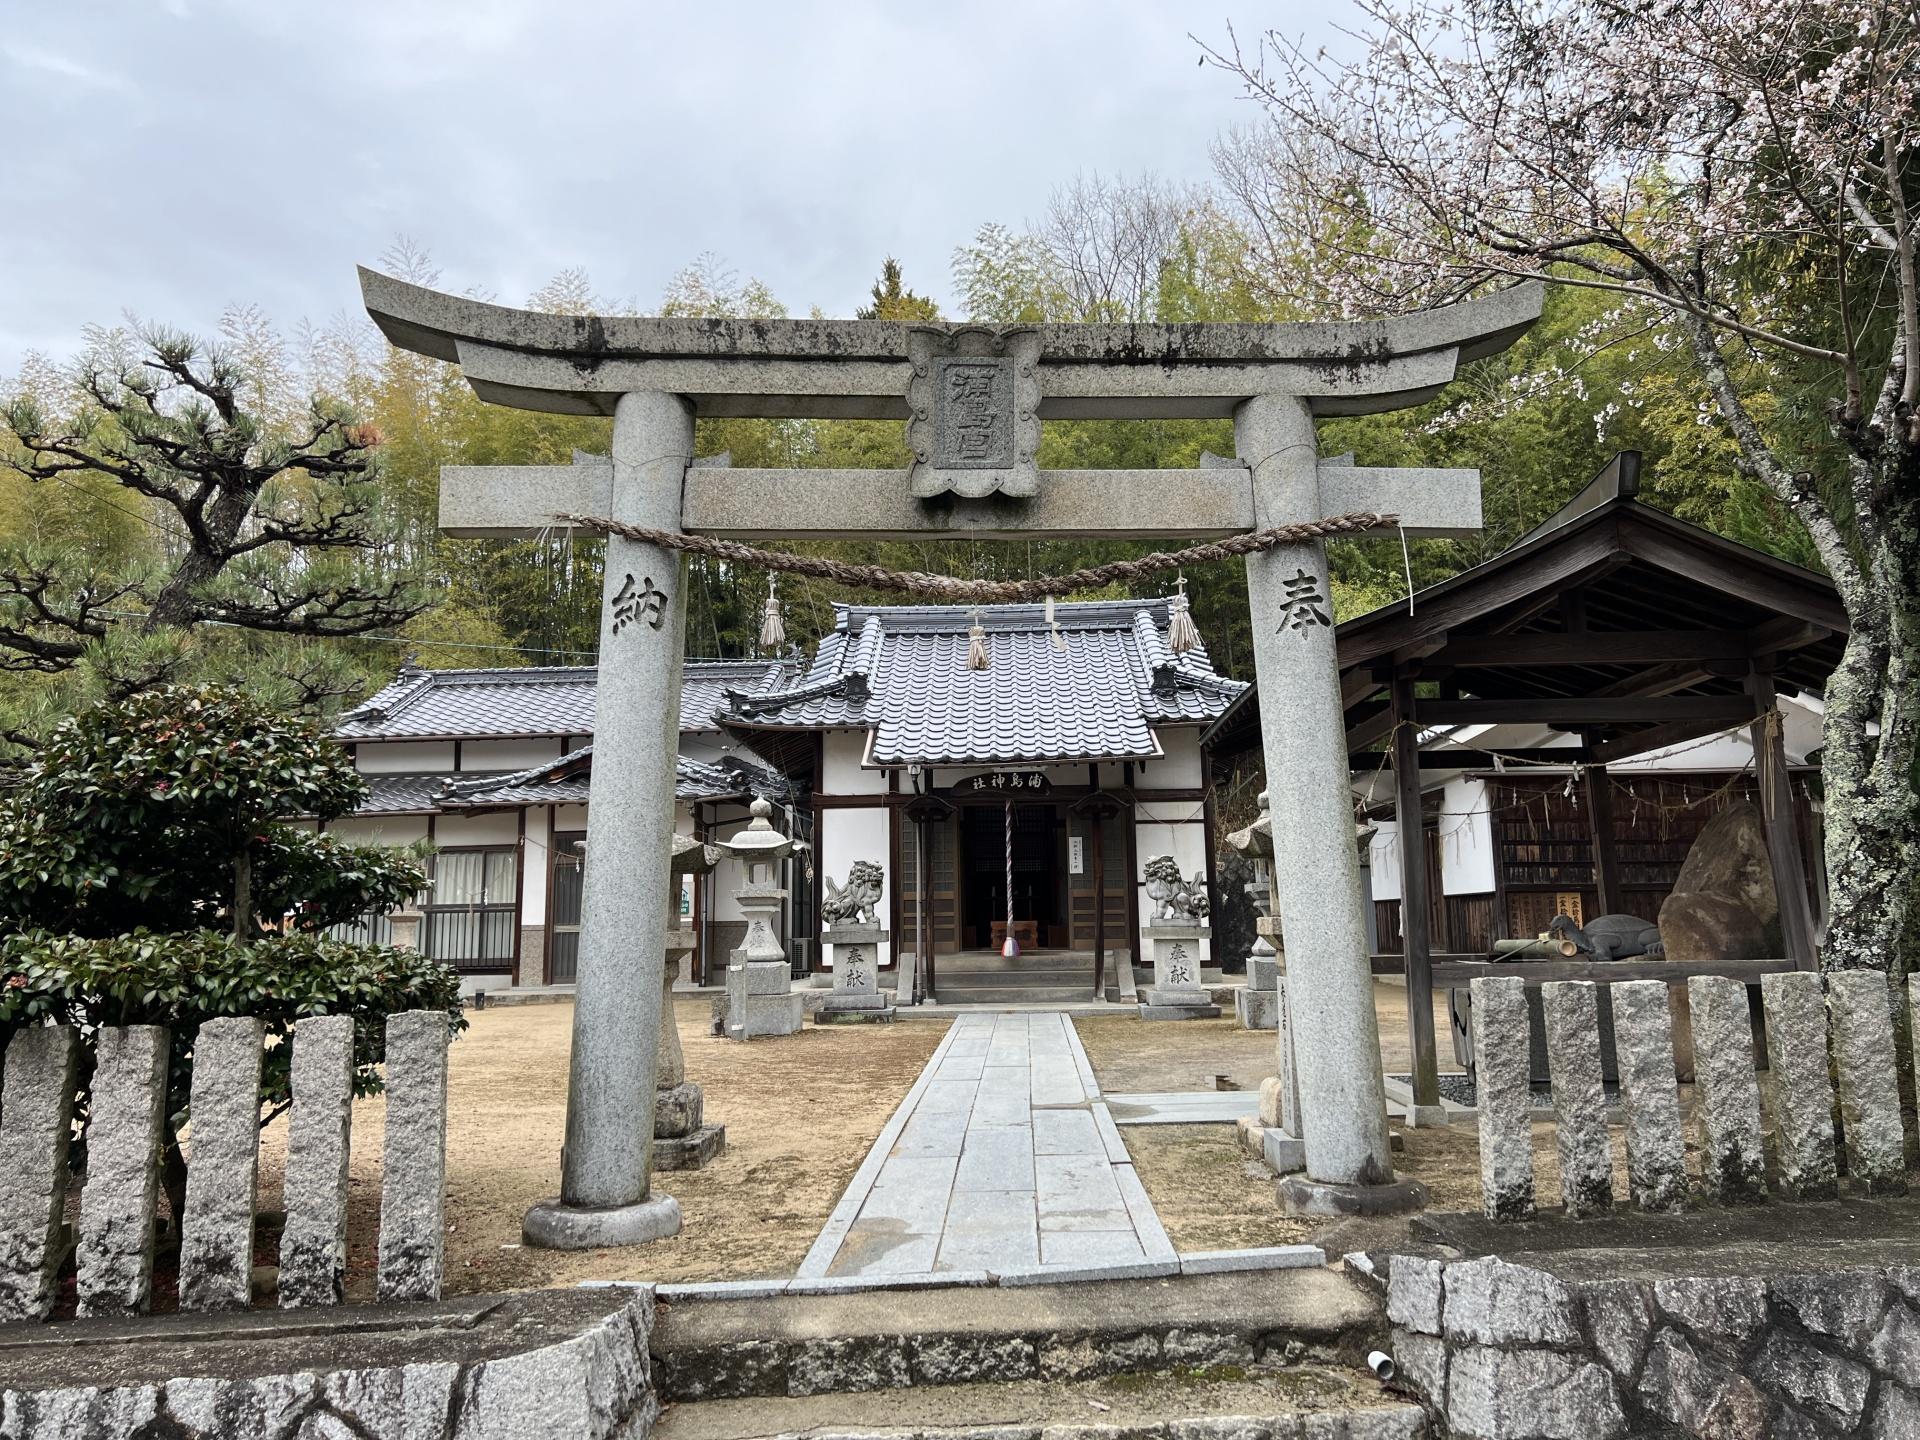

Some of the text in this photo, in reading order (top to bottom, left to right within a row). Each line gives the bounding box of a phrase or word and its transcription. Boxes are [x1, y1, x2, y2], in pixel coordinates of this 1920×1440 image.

[611, 573, 668, 637] 納
[1275, 568, 1332, 641] 奉
[973, 772, 1043, 790] 浦島神社
[846, 946, 865, 988] 奉献
[1169, 943, 1190, 984] 奉献
